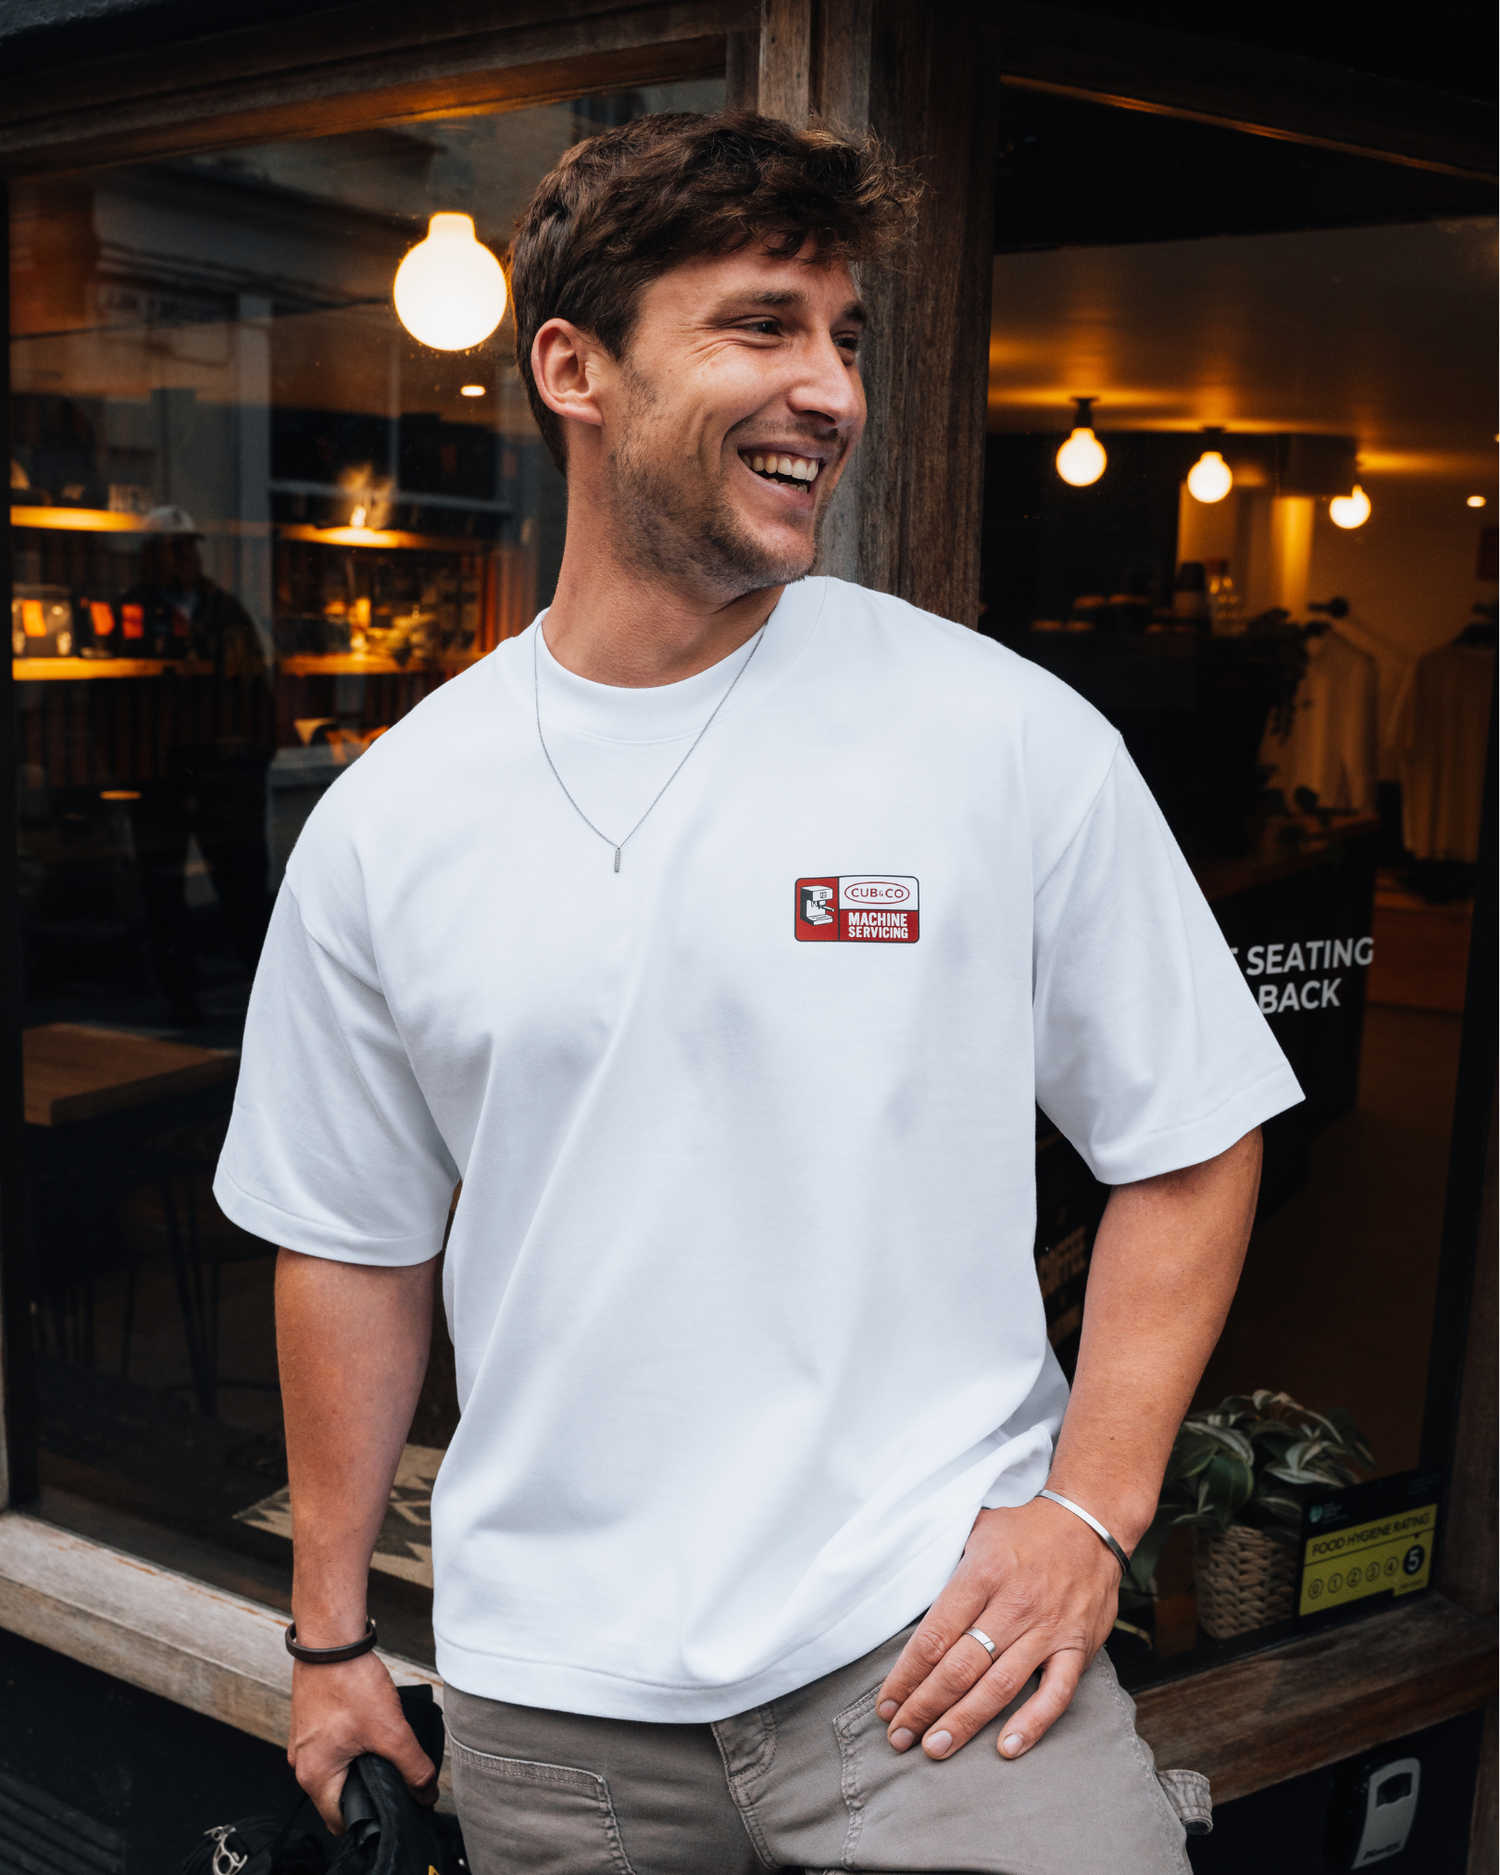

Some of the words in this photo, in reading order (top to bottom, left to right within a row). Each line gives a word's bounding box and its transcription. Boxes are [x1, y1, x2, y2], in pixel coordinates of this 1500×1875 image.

[851, 887, 904, 899] CUB&CO
[848, 911, 908, 927] MACHINE
[848, 926, 909, 939] SERVICING
[1246, 937, 1374, 976] SEATING
[1258, 978, 1342, 1014] BACK
[1312, 1537, 1346, 1556] FOOD
[1347, 1523, 1392, 1546] HYGIENE
[1393, 1512, 1430, 1532] RATING
[1407, 1548, 1421, 1572] 5
